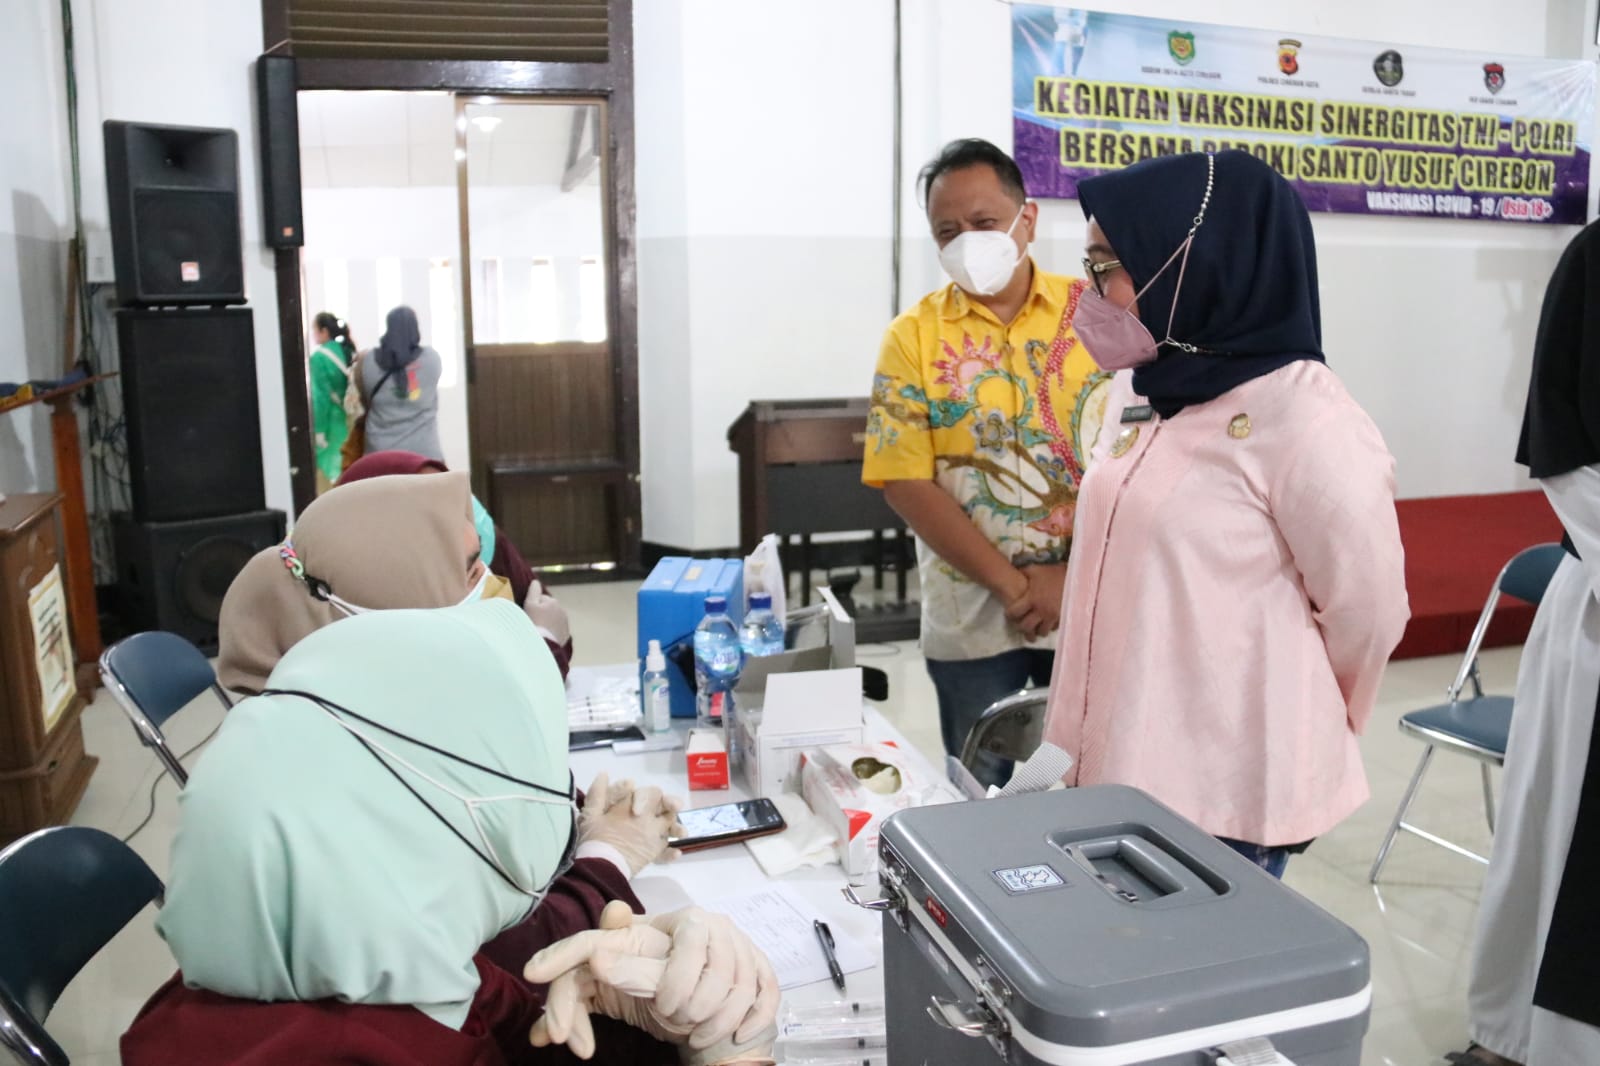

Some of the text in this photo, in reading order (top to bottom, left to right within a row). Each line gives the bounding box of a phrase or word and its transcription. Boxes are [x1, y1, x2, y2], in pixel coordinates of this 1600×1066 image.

[1037, 79, 1170, 122] KEGIATAN
[1177, 90, 1314, 132] VAKSINASI
[1321, 104, 1455, 144] SINERGITAS
[1461, 115, 1497, 147] TNI
[1515, 121, 1575, 152] POLRI
[1301, 147, 1380, 183] SANTO
[1383, 152, 1455, 188] YUSUF
[1459, 158, 1554, 193] CIREBON
[1366, 191, 1434, 212] VAKSINASI
[1435, 194, 1473, 215] COVID
